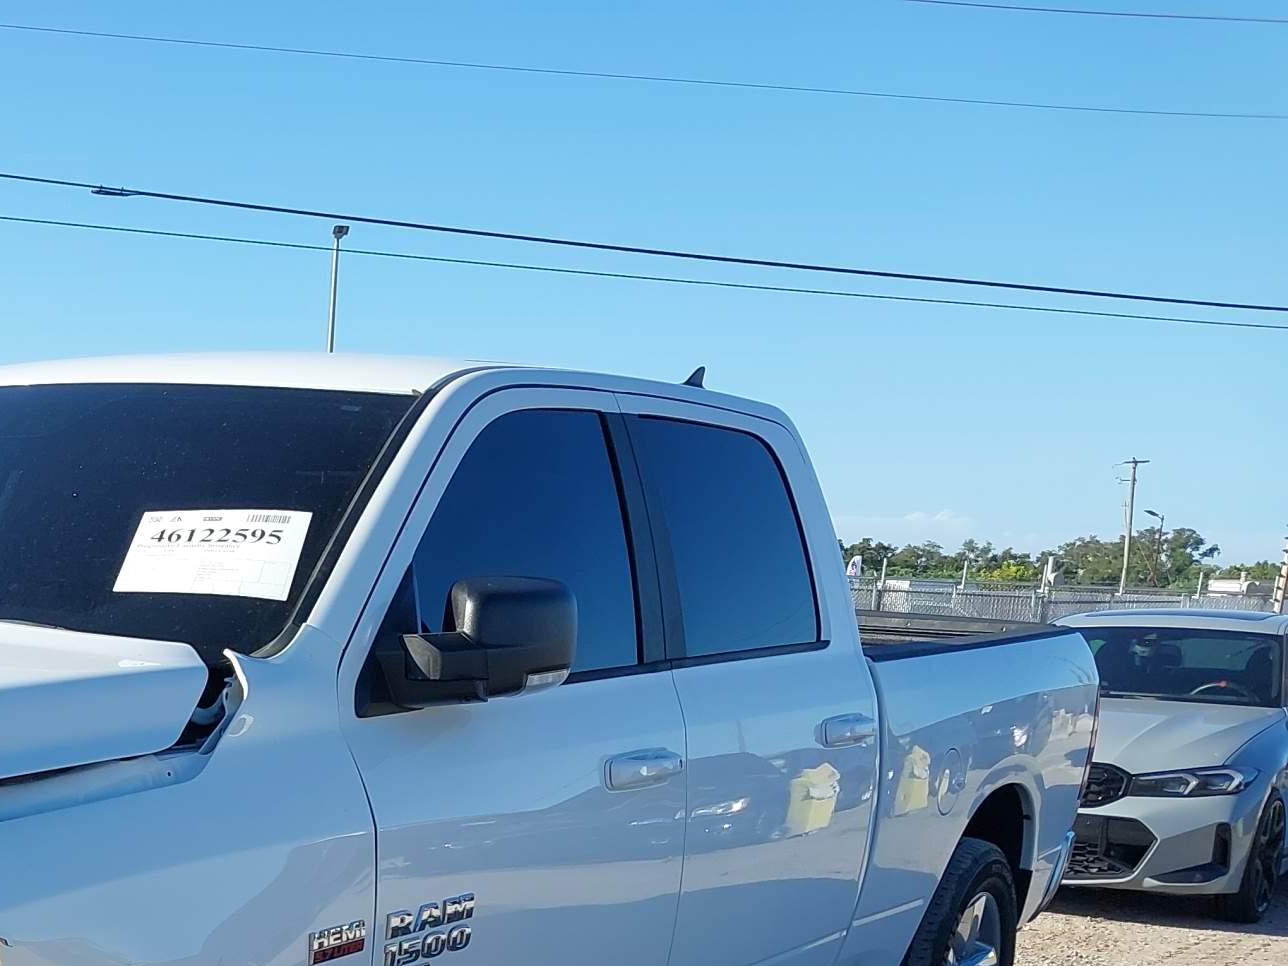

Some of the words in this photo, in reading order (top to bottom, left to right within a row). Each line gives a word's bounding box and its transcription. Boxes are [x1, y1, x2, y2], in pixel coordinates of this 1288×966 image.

[150, 528, 284, 545] 46122595
[385, 892, 475, 940] RAM
[310, 920, 366, 951] HEMI
